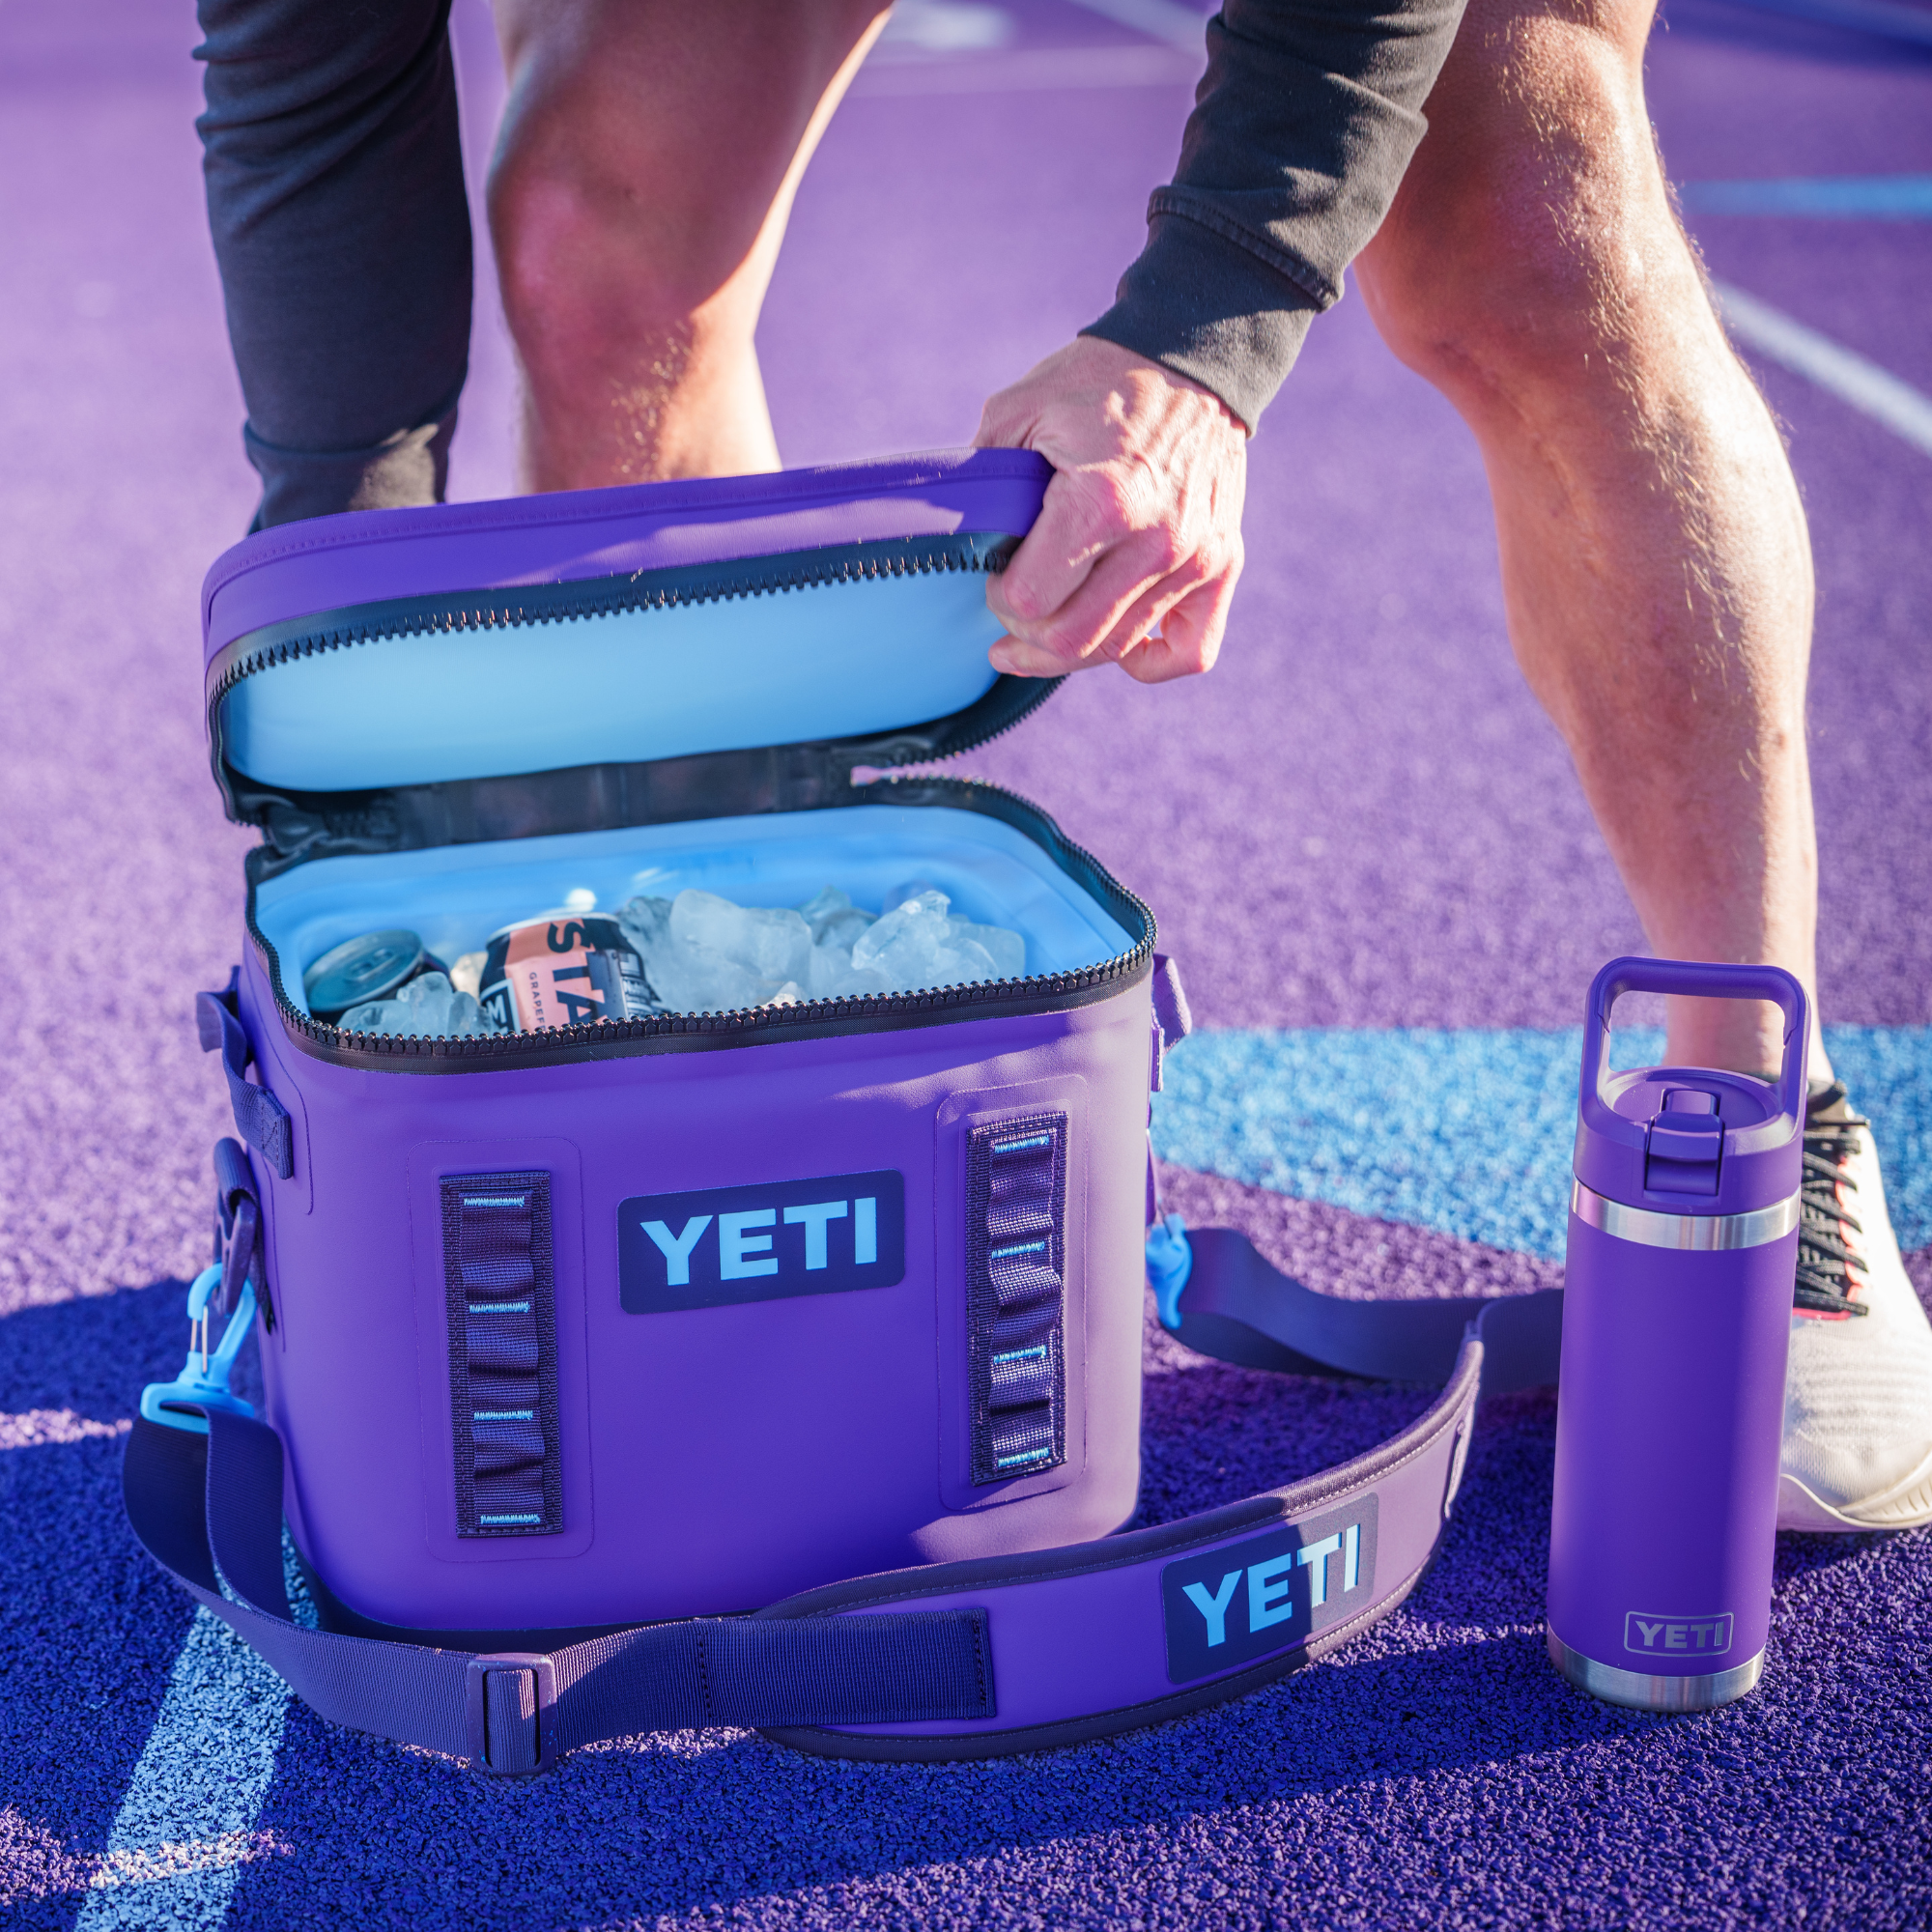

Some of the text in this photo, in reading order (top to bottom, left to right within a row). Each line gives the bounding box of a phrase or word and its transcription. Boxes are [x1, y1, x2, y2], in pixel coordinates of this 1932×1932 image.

[639, 1197, 877, 1286] YETI
[1181, 1523, 1360, 1648] YETI
[1634, 1620, 1724, 1648] YETI
